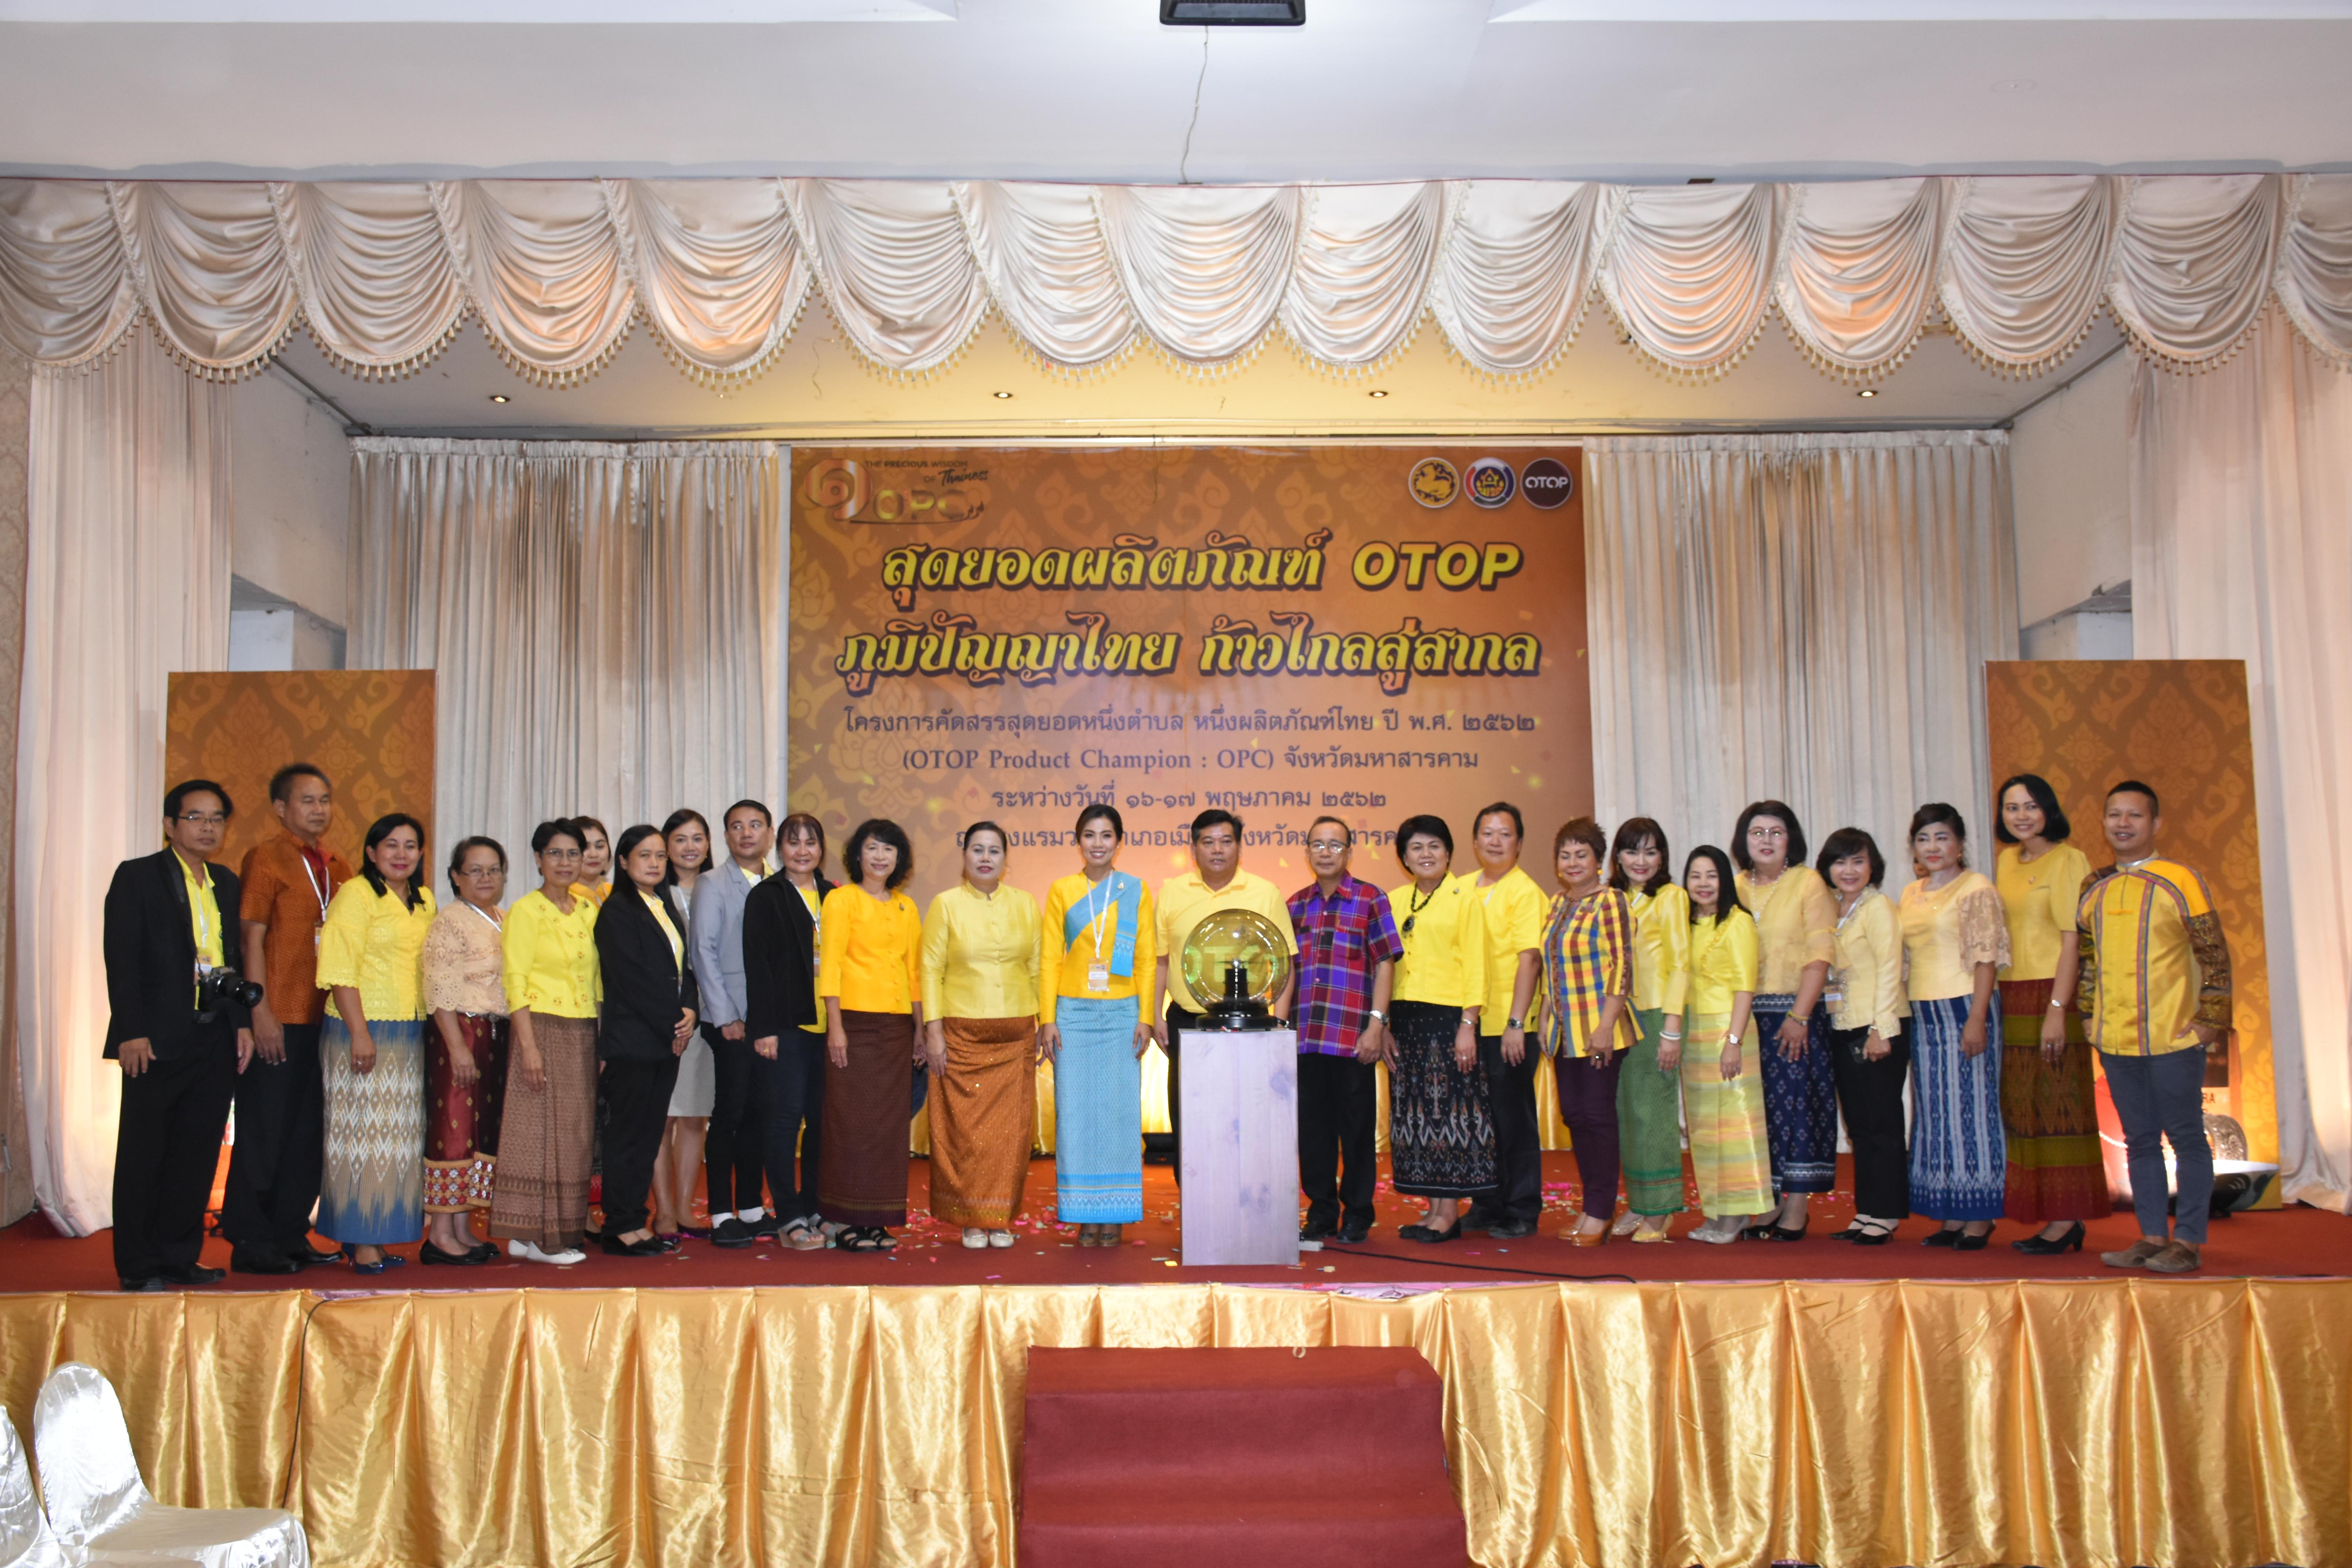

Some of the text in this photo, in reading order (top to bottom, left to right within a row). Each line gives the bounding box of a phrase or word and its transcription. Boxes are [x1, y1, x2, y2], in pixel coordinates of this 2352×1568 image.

[1525, 476, 1568, 489] OTOP
[881, 528, 1524, 612] สุดยอดผลิตภัณฑ์ OTOP
[835, 610, 1541, 697] ภูมิปัญญาไทย ก้าวไกลสู่สากล
[844, 704, 1535, 738] โครงการคัดสรรสุดยอดหนึ่งตำบล หนึ่งผลิตภัณฑ์ไทย ปี พ.ศ. ๒๕๖๒
[902, 750, 978, 771] (OTOP
[989, 749, 1070, 769] Product
[1081, 749, 1191, 775] Champion
[1217, 749, 1274, 771] OPC)
[1284, 745, 1478, 768] จังหวัดมหาสารคาม
[992, 780, 1386, 811] ระหว่างวันที่ ๑๖-๑๗ พฤษภาคม ๒๕๖๒
